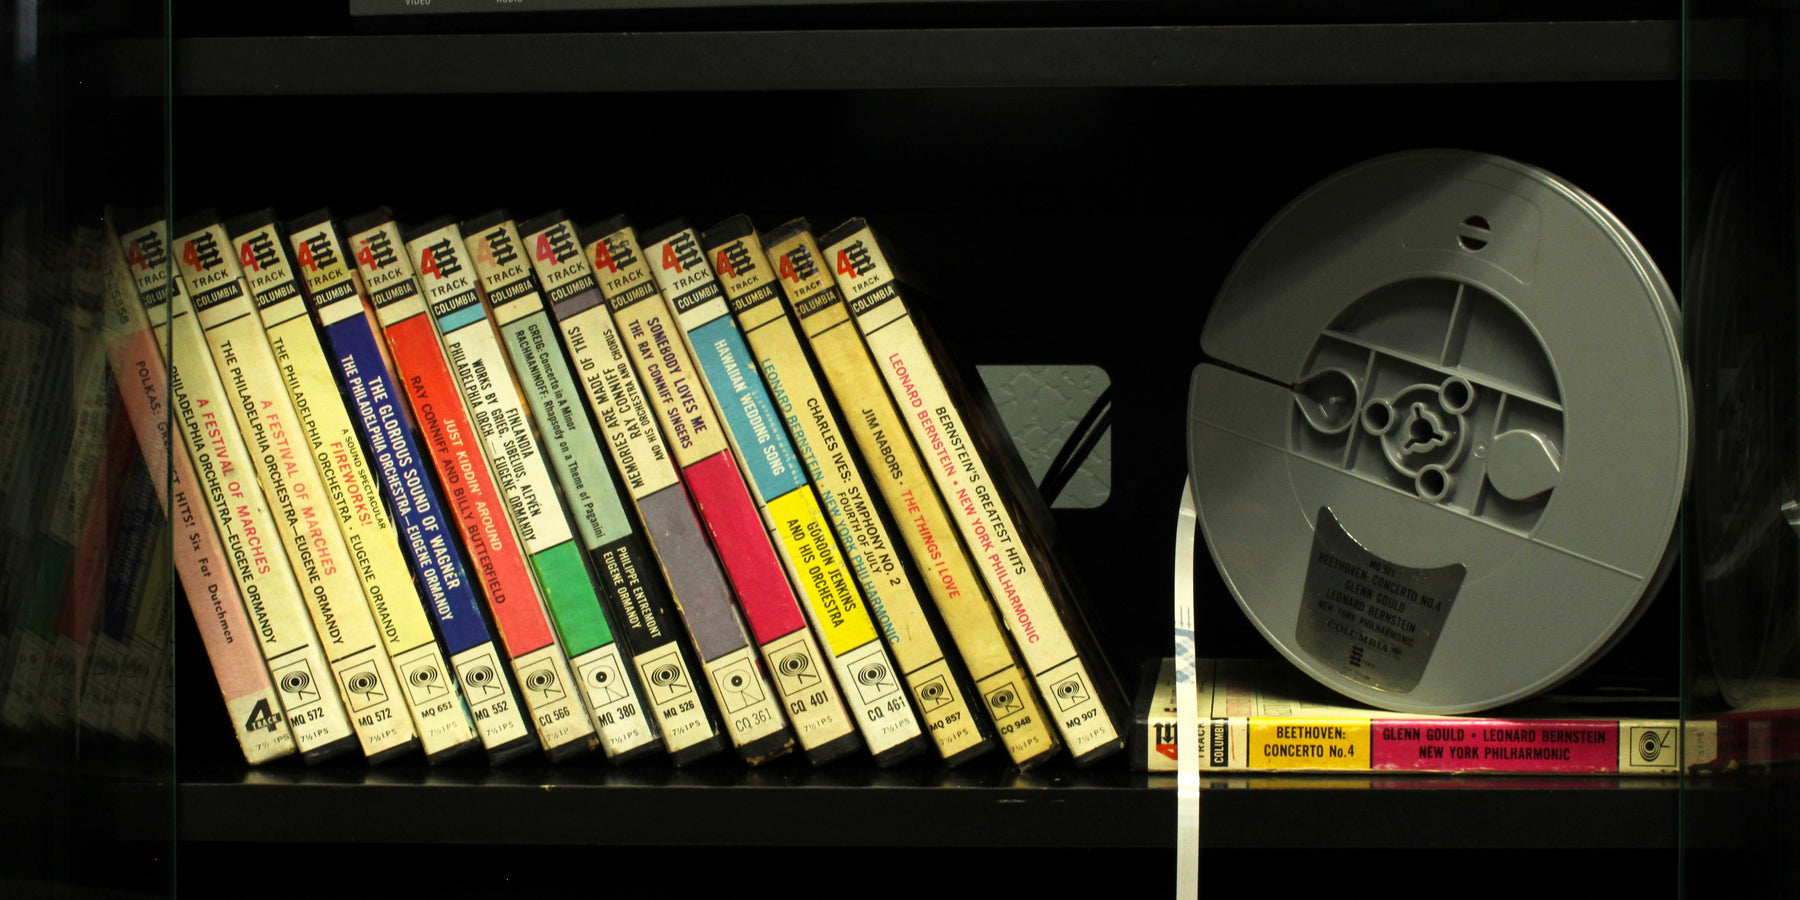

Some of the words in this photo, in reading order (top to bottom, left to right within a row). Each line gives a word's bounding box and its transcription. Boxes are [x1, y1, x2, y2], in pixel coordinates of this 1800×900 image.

[192, 269, 229, 288] TRACK
[431, 277, 468, 298] TRACK
[547, 261, 585, 283] TRACK
[672, 268, 710, 290] TRACK
[196, 286, 238, 307] COLUMBIA
[434, 292, 477, 315] COLUMBIA
[551, 278, 594, 301] COLUMBIA
[677, 284, 719, 309] COLUMBIA
[567, 326, 587, 353] THIS
[602, 328, 622, 360] CHORUS
[341, 354, 358, 377] THE
[527, 323, 545, 352] GREIG:
[539, 351, 559, 389] Concerto
[560, 405, 575, 430] Minor
[579, 357, 594, 370] OF
[617, 362, 630, 379] AND
[646, 316, 681, 373] SOMEBODY
[673, 377, 698, 413] LOVES
[690, 415, 707, 434] ME
[368, 375, 387, 402] THE
[471, 358, 491, 390] WORKS
[484, 392, 498, 404] BY
[587, 372, 609, 404] MADE
[602, 368, 631, 413] CONNIFF
[628, 318, 644, 339] THE
[637, 340, 654, 359] RAY
[647, 363, 673, 403] CONNIFF
[667, 407, 692, 448] SINGERS
[349, 376, 386, 452] PHILADELPHIA
[601, 406, 619, 428] ARE
[624, 380, 649, 426] ORCHESTRA
[714, 339, 747, 392] HAWAIIAN
[740, 392, 770, 444] WEDDING
[763, 444, 784, 475] SONG
[378, 404, 412, 467] GLORIOUS
[448, 341, 483, 409] PHILADELPHIA
[475, 410, 494, 441] ORCH.
[492, 455, 516, 494] EUGENE
[508, 495, 536, 541] ORMANDY
[505, 407, 534, 458] FINLANDIA
[515, 329, 548, 397] RACHMANINOFF:
[543, 399, 564, 439] Rhapsody
[567, 460, 583, 489] Theme
[583, 502, 605, 538] Paganini
[623, 417, 642, 439] RAY
[644, 427, 656, 443] HIS
[611, 432, 644, 489] MEMORIES
[651, 444, 664, 460] AND
[201, 412, 234, 477] FESTIVAL
[227, 481, 244, 498] OF
[236, 504, 270, 574] MARCHES
[220, 339, 237, 366] THE
[230, 366, 269, 453] PHILADELPHIA
[313, 585, 343, 643] ORMANDY
[265, 413, 298, 478] FESTIVAL
[292, 482, 309, 499] OF
[301, 506, 336, 575] MARCHES
[271, 336, 289, 361] THE
[283, 364, 322, 449] PHILADELPHIA
[317, 452, 351, 523] ORCHESTRA
[349, 534, 375, 582] EUGENE
[369, 585, 399, 642] ORMANDY
[330, 441, 372, 526] FIREWORKS!
[345, 435, 361, 467] SOUND
[357, 468, 386, 529] SPECTACULAR
[403, 468, 430, 513] SOUND
[410, 375, 427, 398] RAY
[421, 403, 448, 452] CONNIFF
[442, 459, 459, 483] AND
[453, 486, 474, 519] BILLY
[467, 524, 505, 604] BUTTERFIELD
[443, 419, 463, 445] JUST
[455, 450, 481, 495] KIDDIN'
[475, 501, 502, 550] AROUND
[806, 397, 838, 451] CHARLES
[831, 452, 851, 483] IVES:
[847, 486, 885, 549] SYMPHONY
[878, 553, 894, 575] NO.
[888, 352, 922, 407] LEONARD
[916, 409, 956, 476] BERNSTEIN
[955, 488, 976, 515] NEW
[971, 517, 994, 552] YORK
[988, 553, 1039, 643] PHILHARMONIC
[935, 406, 980, 482] BERNSTEIN'S
[975, 485, 1011, 542] GREATEST
[1005, 547, 1025, 574] HITS
[135, 359, 160, 415] POLKAS:
[175, 491, 195, 527] HITS!
[207, 583, 233, 643] Dutchmen
[758, 357, 792, 415] LEONARD
[784, 414, 823, 483] BERNSTEIN
[819, 490, 841, 519] NEW
[833, 519, 856, 554] YORK
[849, 554, 899, 647] PHILHARMONIC
[861, 408, 879, 429] JIM
[872, 429, 902, 479] NABORS
[901, 488, 920, 514] THE
[913, 514, 941, 559] THINGS
[938, 568, 960, 599] LOVE
[421, 515, 438, 531] OF
[837, 491, 862, 532] FOURTH
[856, 534, 869, 546] OF
[863, 551, 881, 573] JULY
[429, 534, 460, 589] WAGNER
[786, 519, 805, 541] AND
[798, 543, 815, 563] HIS
[808, 565, 844, 628] ORCHESTRA
[806, 521, 834, 566] GORDON
[827, 568, 856, 612] JENKINS
[423, 568, 453, 620] ORMANDY
[602, 551, 623, 585] EUGENE
[617, 586, 641, 628] ORMANDY
[616, 546, 639, 585] PHILIPPE
[632, 586, 661, 637] ENTREMONT
[1345, 579, 1372, 599] GLENN
[1376, 593, 1406, 613] GOULD
[1371, 574, 1418, 602] CONCERTO
[246, 584, 276, 642] ORMANDY
[1318, 600, 1333, 613] NEW
[1338, 608, 1356, 622] YORK
[1359, 617, 1415, 647] PHILHARMONIC
[1326, 589, 1365, 612] LEONARD
[1368, 605, 1417, 634] BERNSTEIN
[1327, 620, 1389, 653] COLUMBIA
[306, 707, 324, 722] 572
[374, 708, 392, 723] 572
[436, 701, 453, 715] 651
[491, 701, 508, 718] 552
[554, 706, 570, 723] 566
[618, 704, 636, 720] 380
[679, 700, 695, 714] 526
[810, 691, 829, 707] 401
[887, 697, 906, 715] 461
[1081, 709, 1097, 722] 907
[753, 708, 772, 726] 361
[945, 712, 962, 726] 857
[1014, 716, 1032, 728] 948
[1276, 726, 1346, 739] BEETHOVEN:
[1264, 744, 1324, 758] CONCERTO
[1383, 728, 1420, 740] GLENN
[1427, 728, 1465, 742] GOULD
[1483, 728, 1536, 742] LEONARD
[1542, 729, 1606, 744] BERNSTEIN
[1419, 745, 1445, 759] NEW
[1449, 745, 1478, 759] YORK
[1484, 746, 1571, 761] PHILHARMONIC
